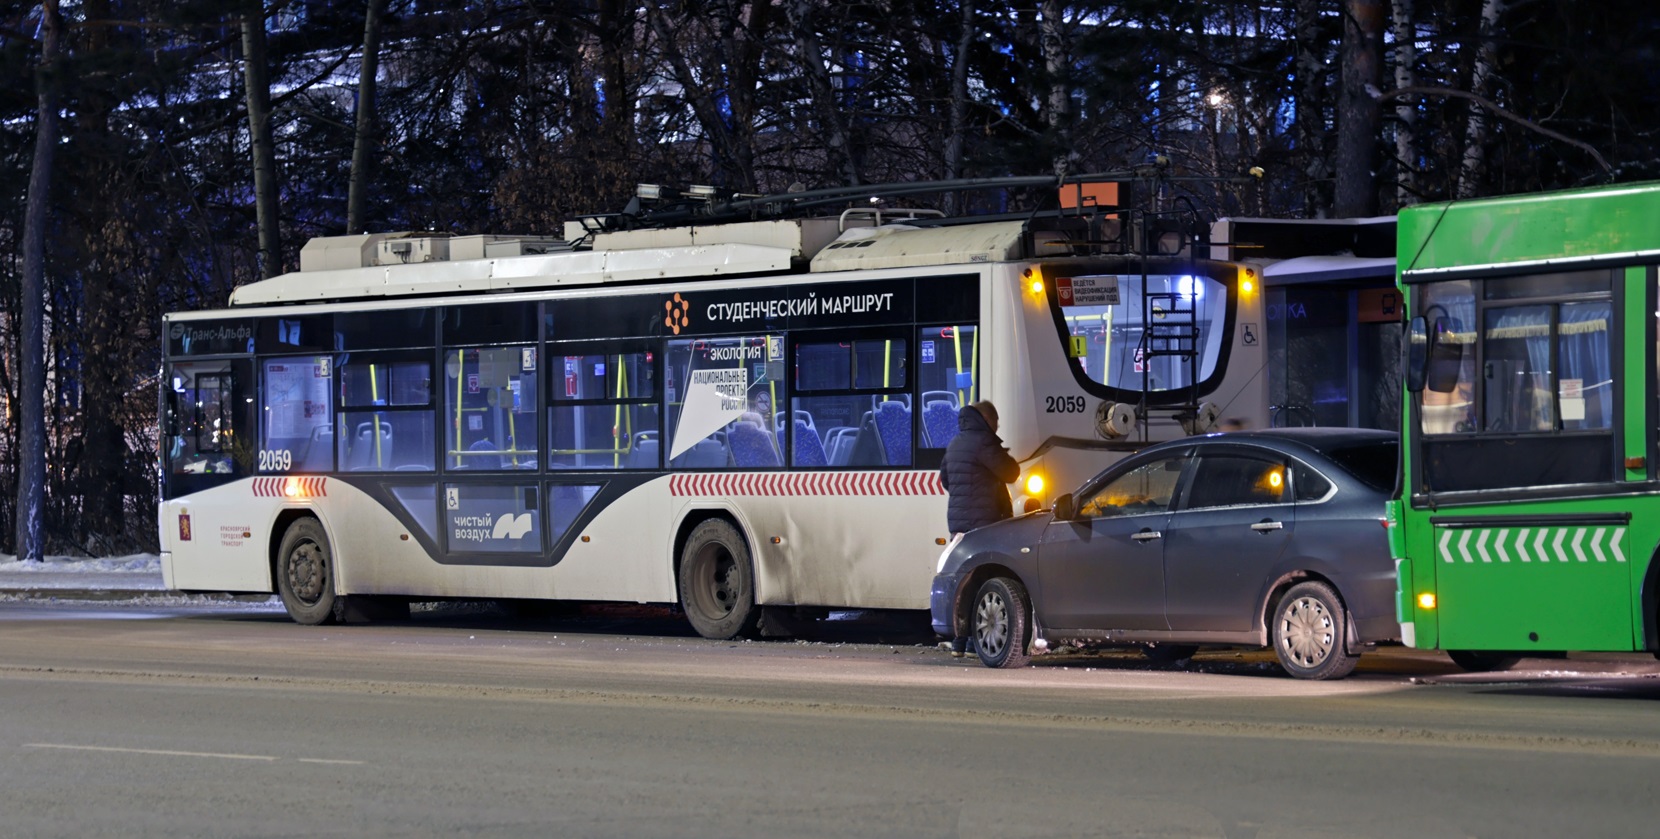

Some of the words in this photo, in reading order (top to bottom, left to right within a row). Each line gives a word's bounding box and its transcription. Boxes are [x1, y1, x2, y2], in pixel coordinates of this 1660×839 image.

[1073, 279, 1096, 287] ВЕДЁТСЯ
[1074, 286, 1117, 295] ВИДЕОФИКСАЦИЯ
[1075, 294, 1105, 302] НАРУШЕНИЙ
[706, 292, 818, 321] СТУДЕНЧЕСКИЙ
[821, 293, 893, 315] МАРШРУТ
[187, 323, 251, 344] Транс-Альфа
[710, 346, 761, 361] ЭКОЛОГИЯ
[693, 370, 746, 385] НАЦИОНАЛЬНЫЕ
[716, 384, 746, 397] ПРОЕКТЫ
[1045, 396, 1086, 413] 2059
[258, 449, 292, 471] 2059
